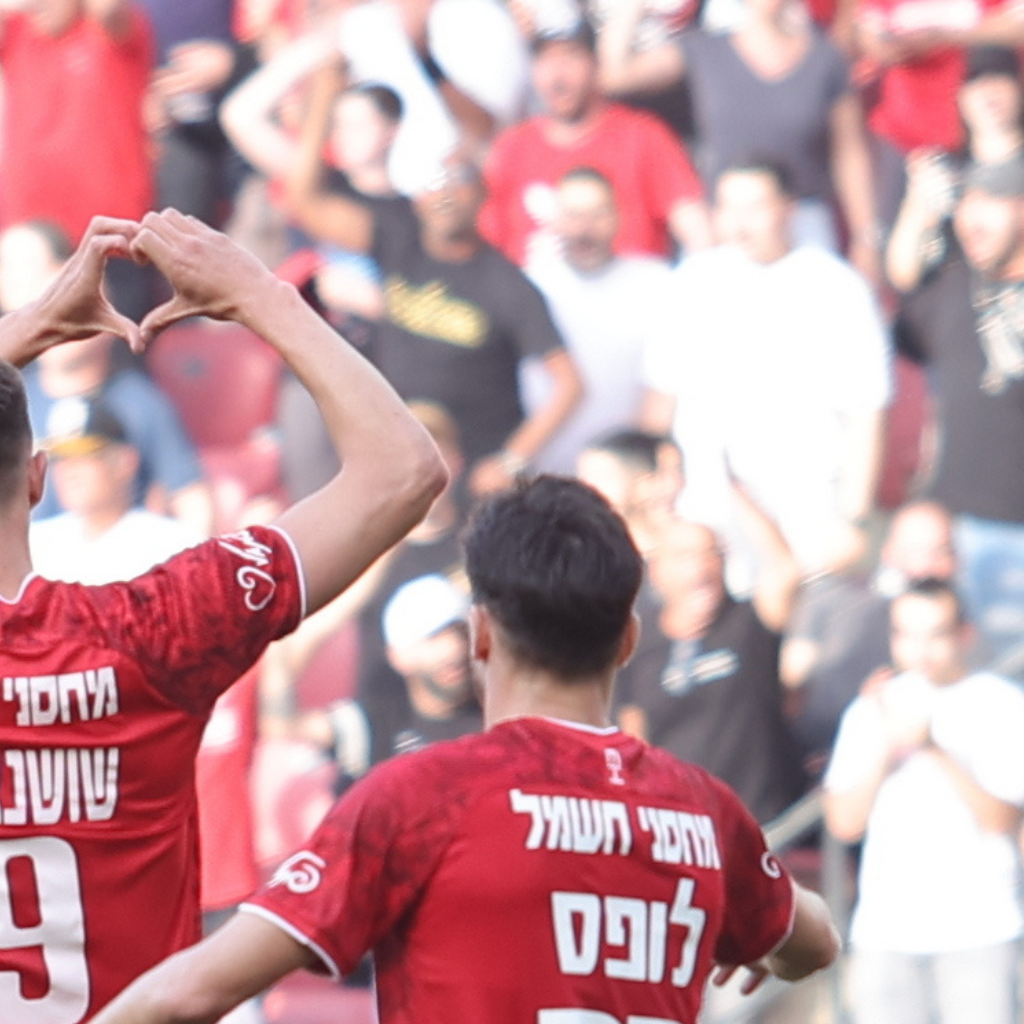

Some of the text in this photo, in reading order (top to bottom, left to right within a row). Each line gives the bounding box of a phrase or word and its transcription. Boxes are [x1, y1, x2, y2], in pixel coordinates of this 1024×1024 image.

[3, 666, 119, 726] מחסני
[508, 788, 633, 855] חשמל
[637, 805, 722, 870] מחסני
[551, 877, 707, 988] לופס
